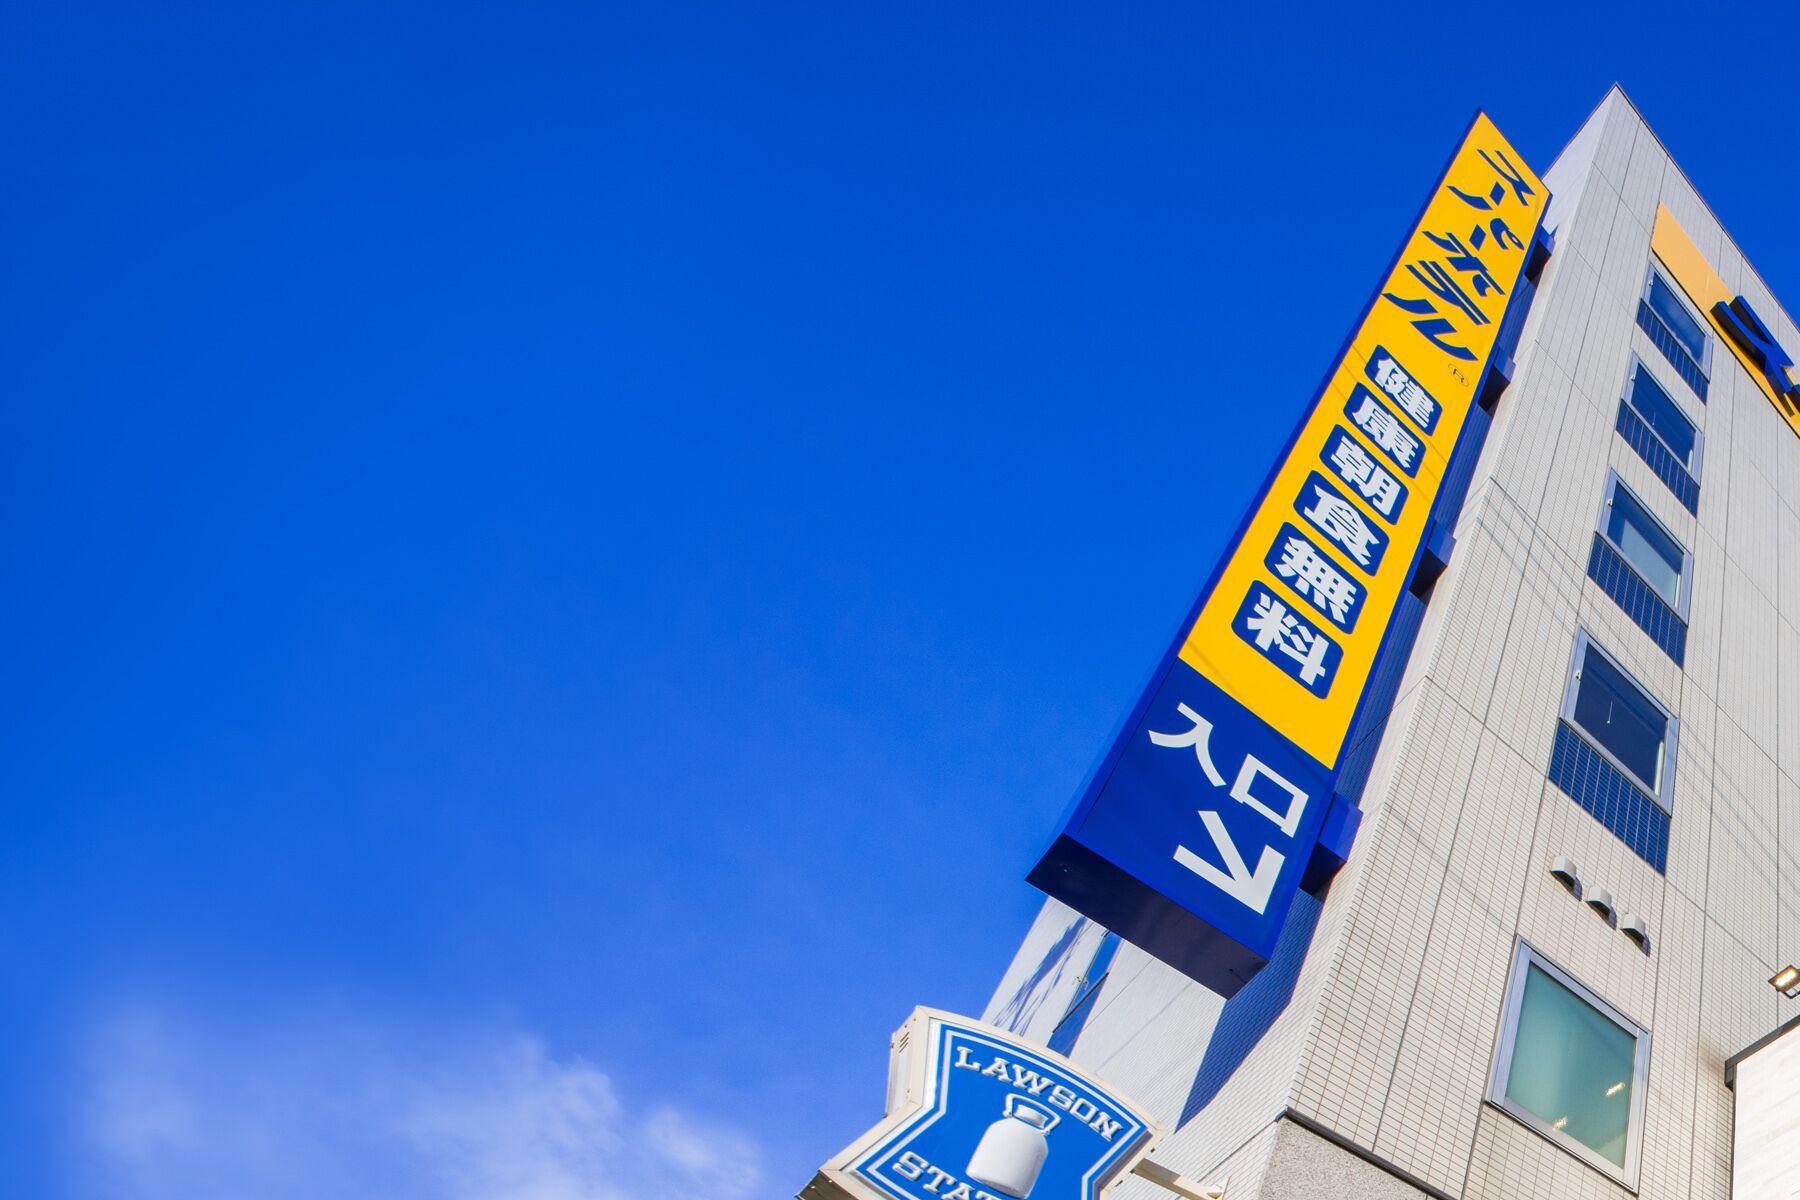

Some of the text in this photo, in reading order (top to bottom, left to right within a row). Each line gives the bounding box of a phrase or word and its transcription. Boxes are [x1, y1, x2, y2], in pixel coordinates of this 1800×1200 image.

[1246, 356, 1435, 689] 健康朝食無料
[1148, 702, 1310, 840] 入口
[955, 1045, 1124, 1142] LAWSON
